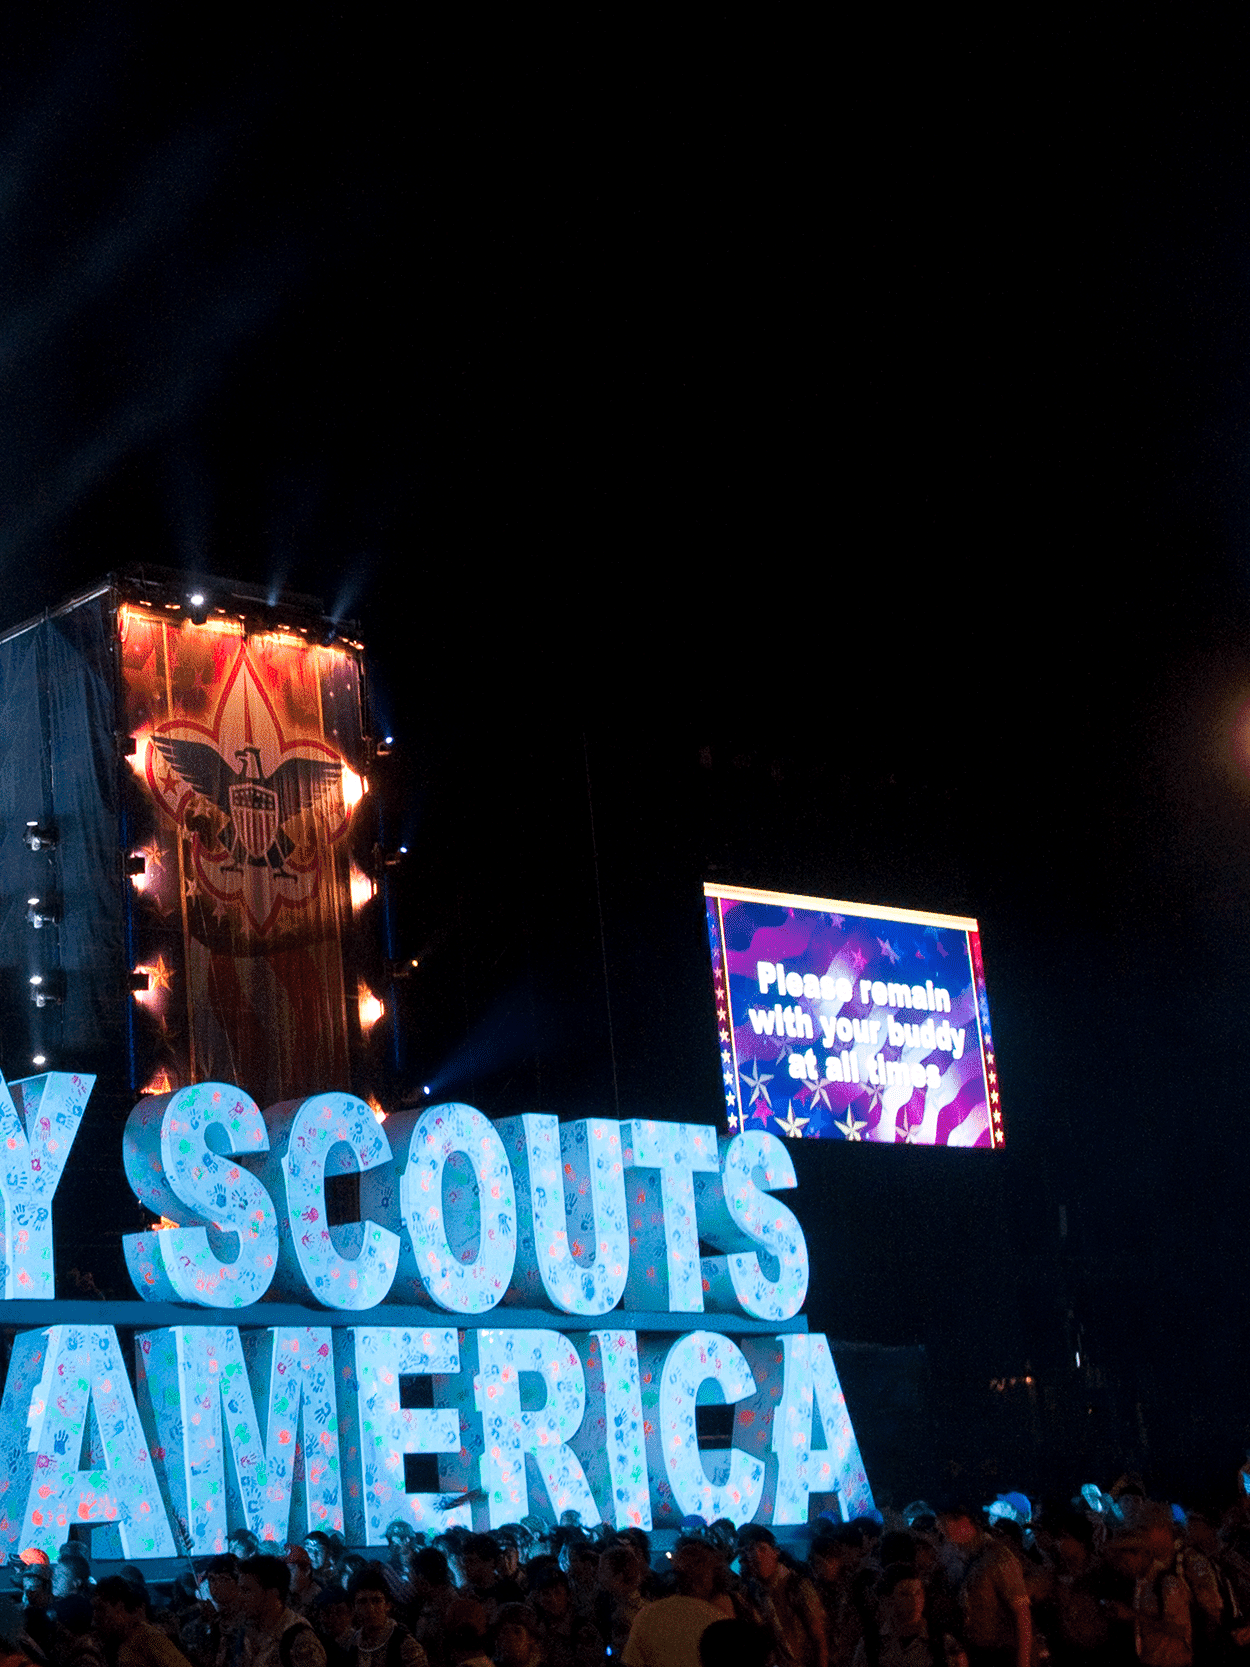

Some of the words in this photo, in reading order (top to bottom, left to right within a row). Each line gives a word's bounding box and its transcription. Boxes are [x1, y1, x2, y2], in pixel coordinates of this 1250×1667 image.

[756, 961, 854, 1003] Please
[860, 979, 951, 1012] remain
[748, 1003, 814, 1040] with
[822, 1014, 882, 1048] your
[887, 1014, 966, 1060] buddy
[787, 1048, 819, 1081] at
[825, 1050, 860, 1083] all
[866, 1053, 942, 1090] times
[123, 1082, 810, 1322] SCOUTS
